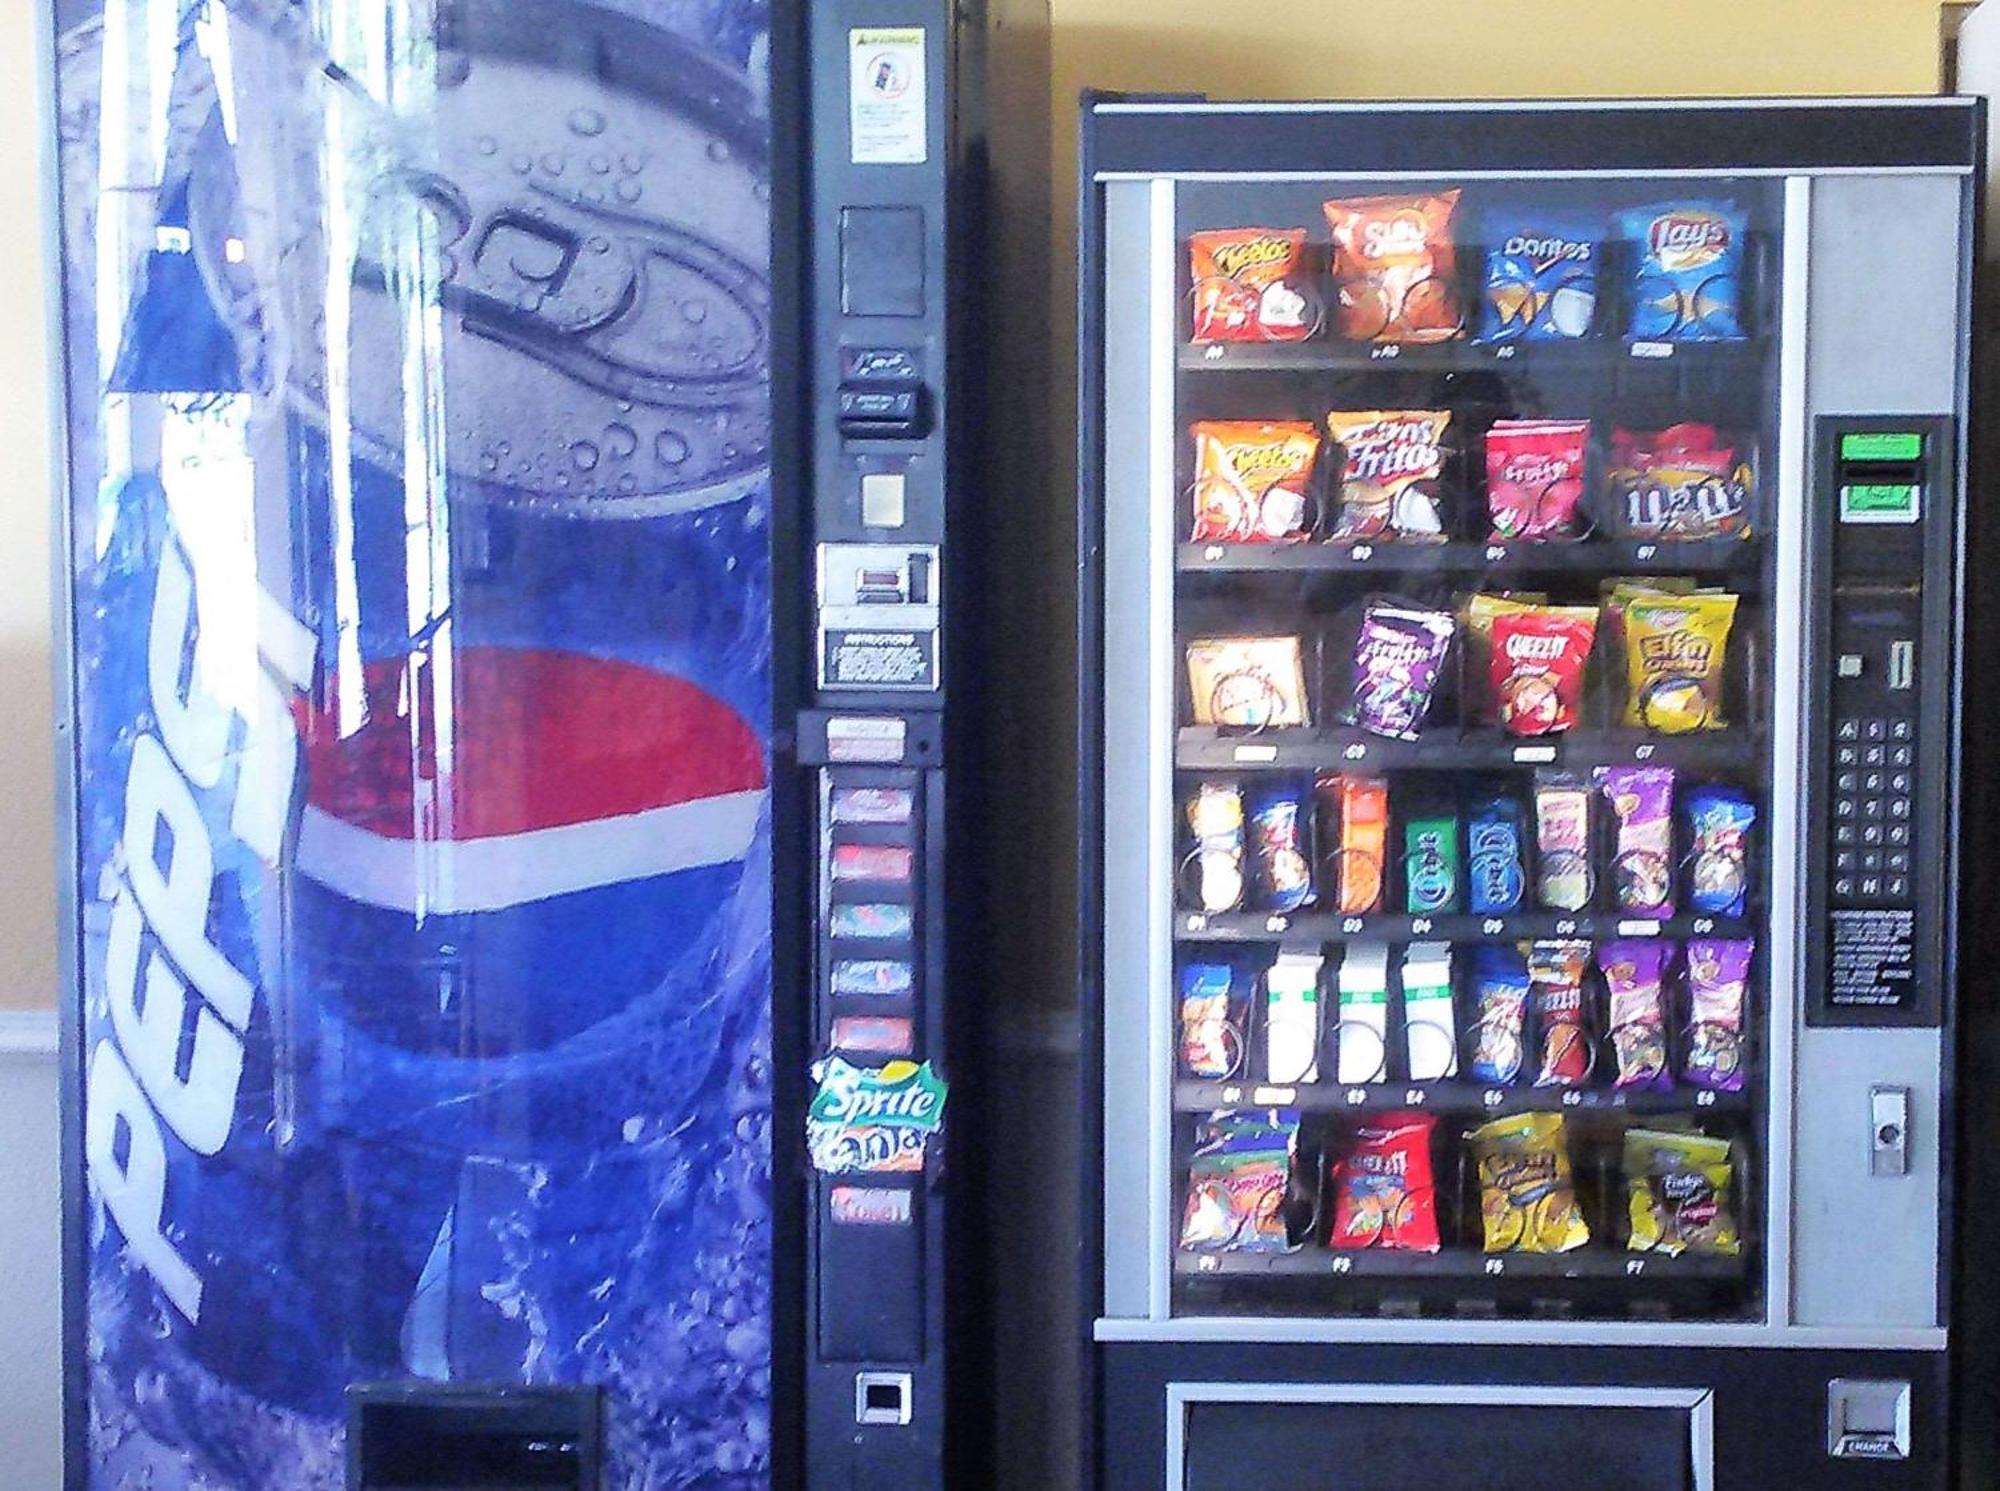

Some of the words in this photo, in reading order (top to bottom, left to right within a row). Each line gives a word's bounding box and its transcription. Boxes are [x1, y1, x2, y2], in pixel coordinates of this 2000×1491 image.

[1504, 236, 1591, 260] Doritos
[1347, 443, 1439, 478] Fritos
[1840, 722, 1854, 737] A
[1866, 800, 1878, 815] 7
[823, 1078, 937, 1126] Sprite
[1847, 1441, 1891, 1453] CHANGE
